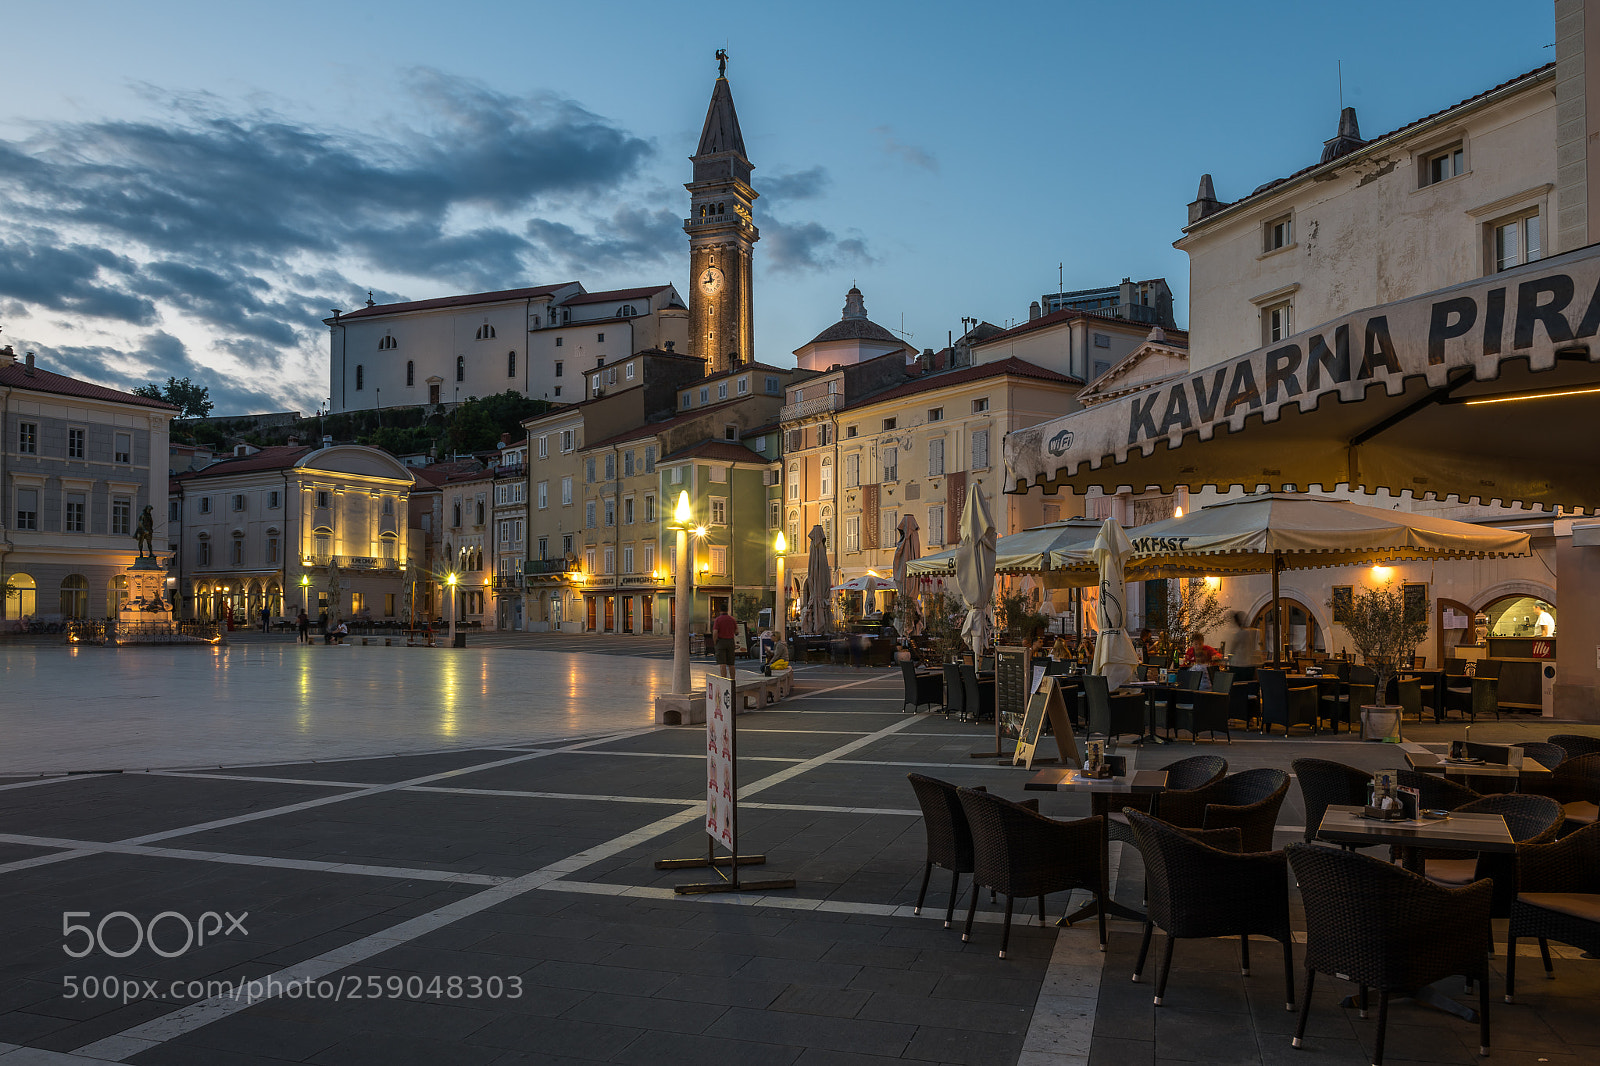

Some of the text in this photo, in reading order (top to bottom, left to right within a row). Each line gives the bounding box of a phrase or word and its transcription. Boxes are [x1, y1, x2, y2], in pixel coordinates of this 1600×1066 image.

[1127, 315, 1403, 445] KAVARNA
[1132, 537, 1189, 552] AKFAST
[1533, 641, 1550, 657] illy
